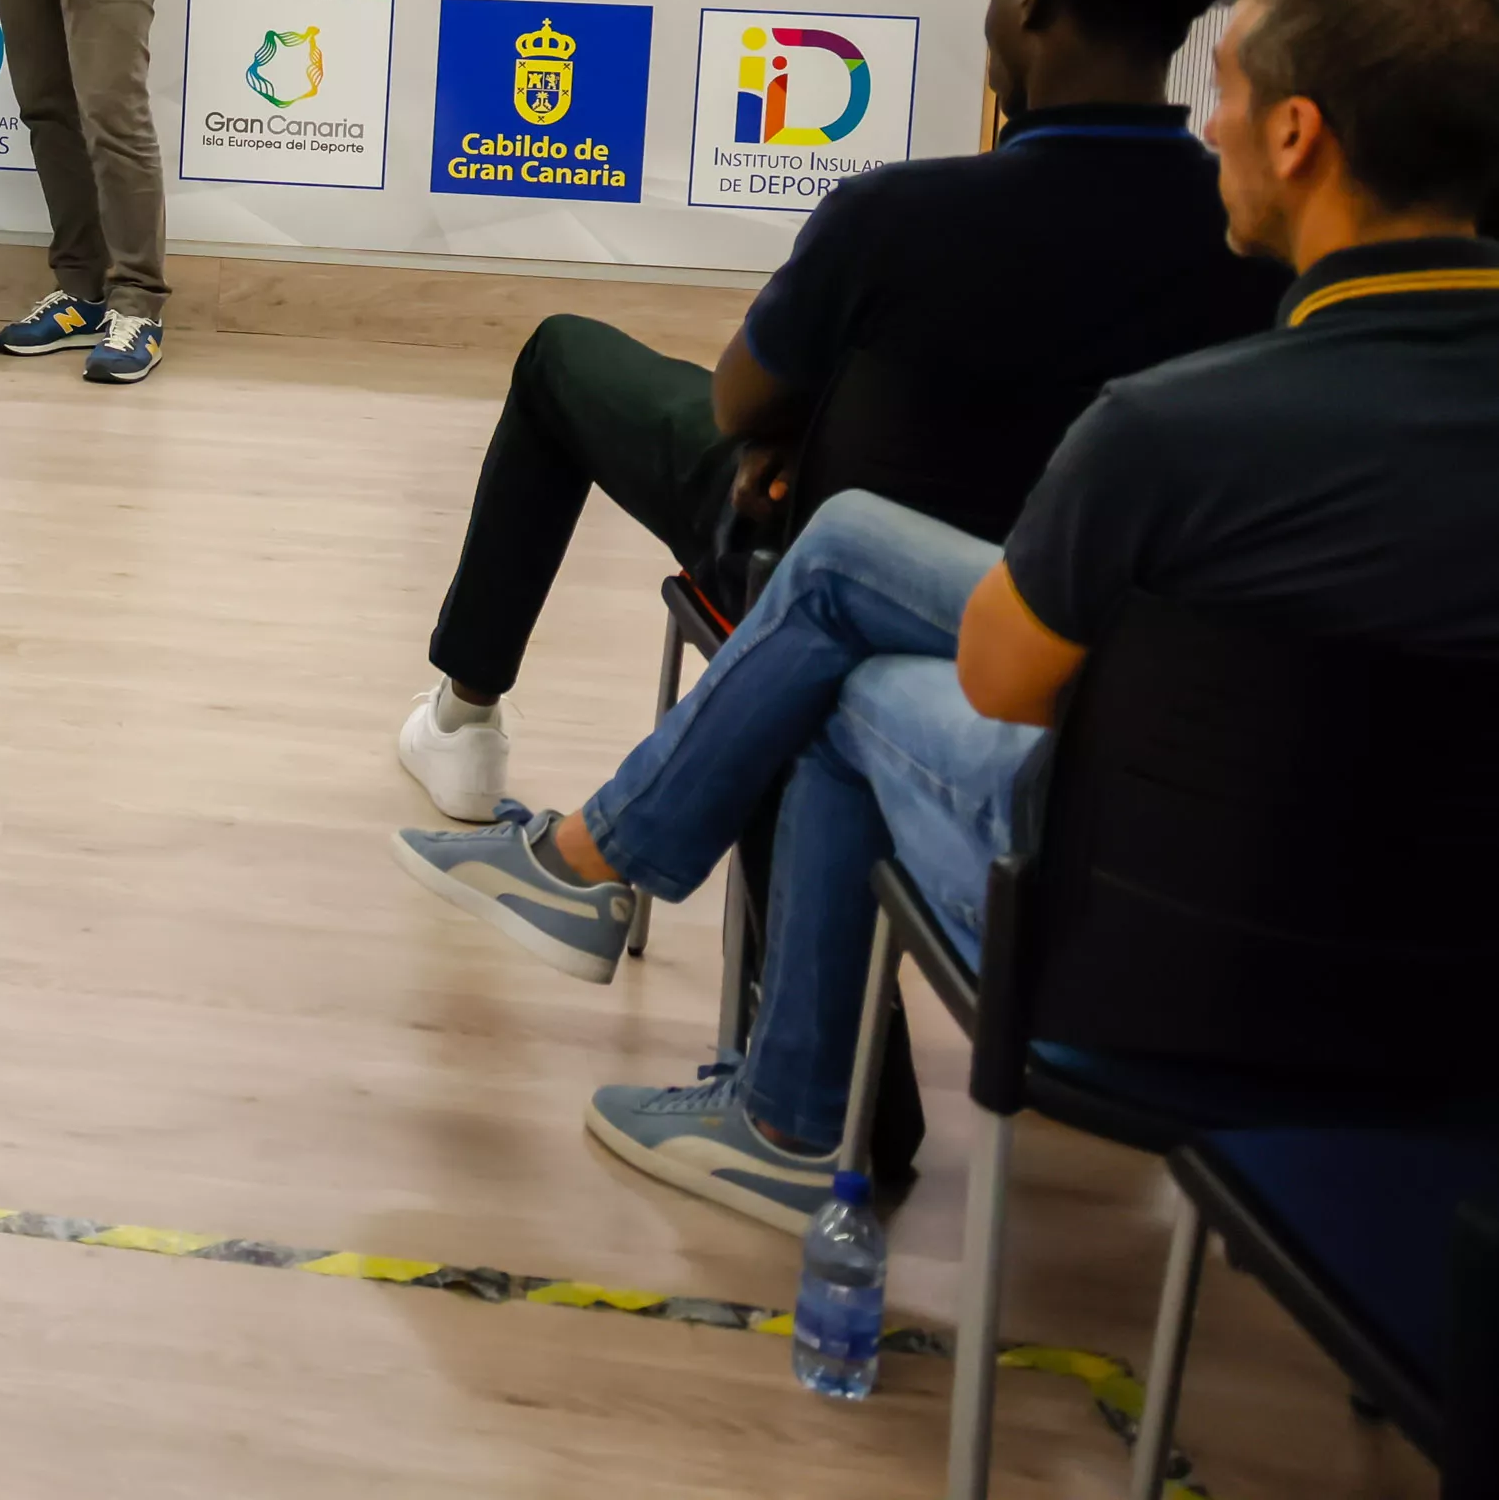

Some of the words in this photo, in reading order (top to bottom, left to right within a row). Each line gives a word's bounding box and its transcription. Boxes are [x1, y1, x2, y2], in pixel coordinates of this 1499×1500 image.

[205, 111, 264, 134] Gran
[267, 114, 364, 139] Canaria
[202, 135, 224, 146] Isla
[228, 136, 282, 150] Europea
[285, 139, 306, 150] del
[310, 140, 364, 154] Deporte
[461, 132, 568, 159] Cabildo
[574, 137, 609, 161] de
[447, 157, 514, 181] Gran
[520, 160, 626, 187] Canaria
[719, 178, 742, 193] DE
